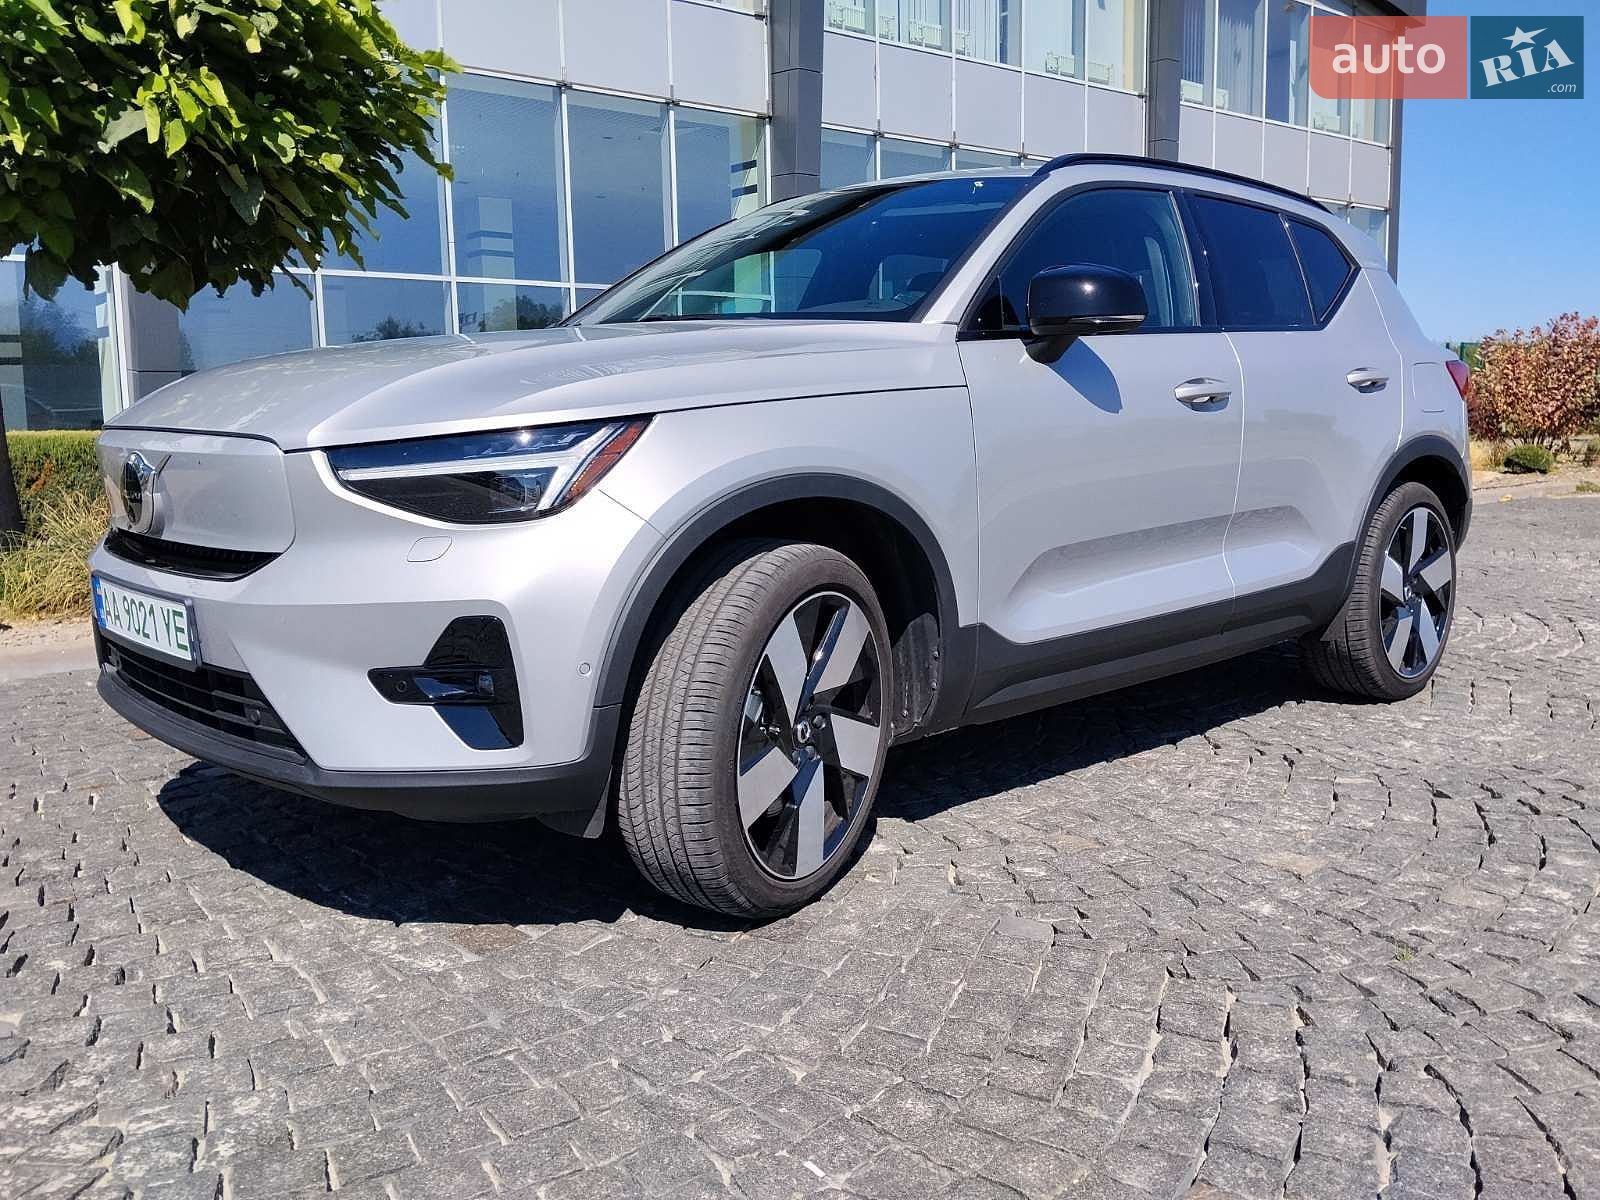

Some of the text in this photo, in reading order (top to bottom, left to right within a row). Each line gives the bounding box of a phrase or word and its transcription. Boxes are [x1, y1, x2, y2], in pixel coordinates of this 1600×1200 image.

[104, 587, 123, 629] AA
[123, 595, 159, 642] 9021
[160, 606, 189, 652] YE
